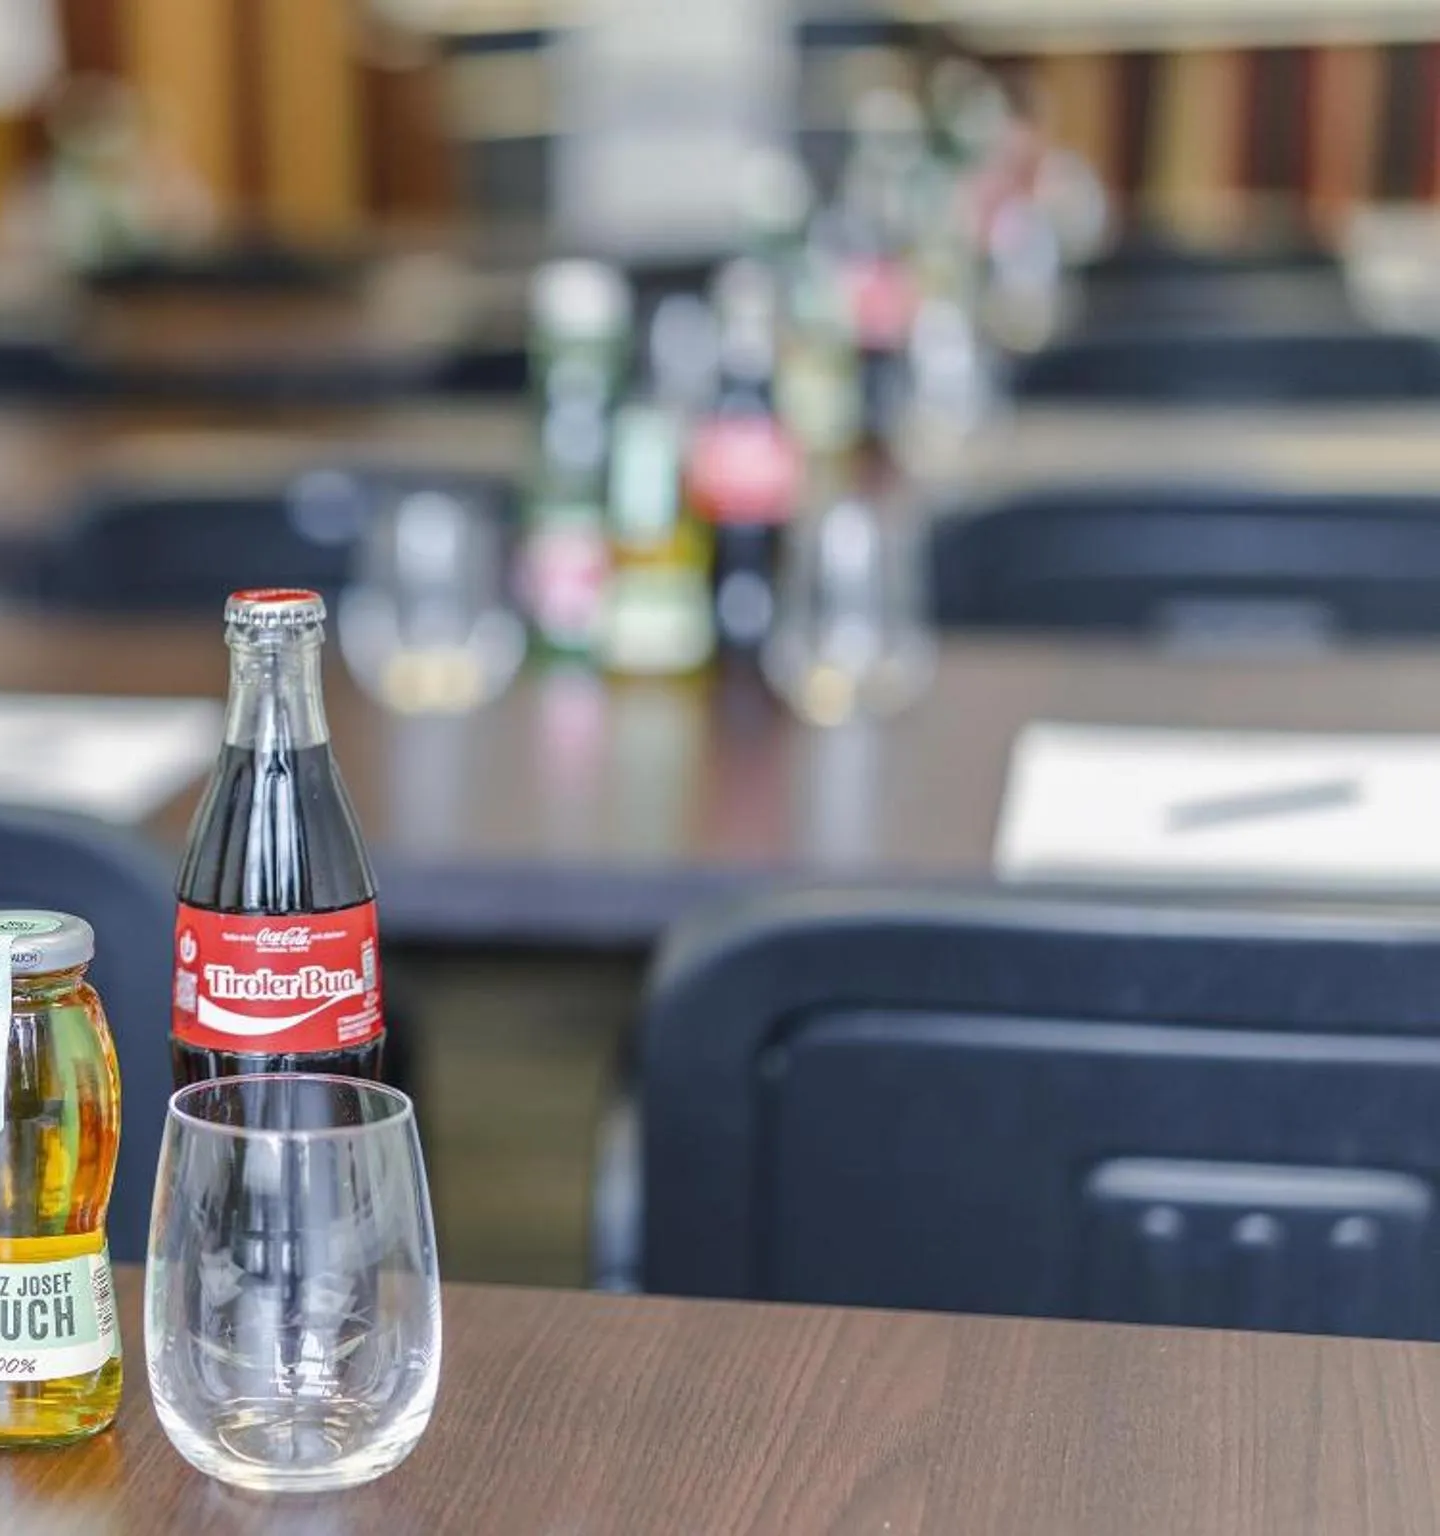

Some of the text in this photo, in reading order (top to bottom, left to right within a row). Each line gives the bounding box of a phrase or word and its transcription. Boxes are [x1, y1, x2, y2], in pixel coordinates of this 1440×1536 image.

[206, 967, 356, 997] Tiroler Bua
[16, 1272, 72, 1297] JOSEF
